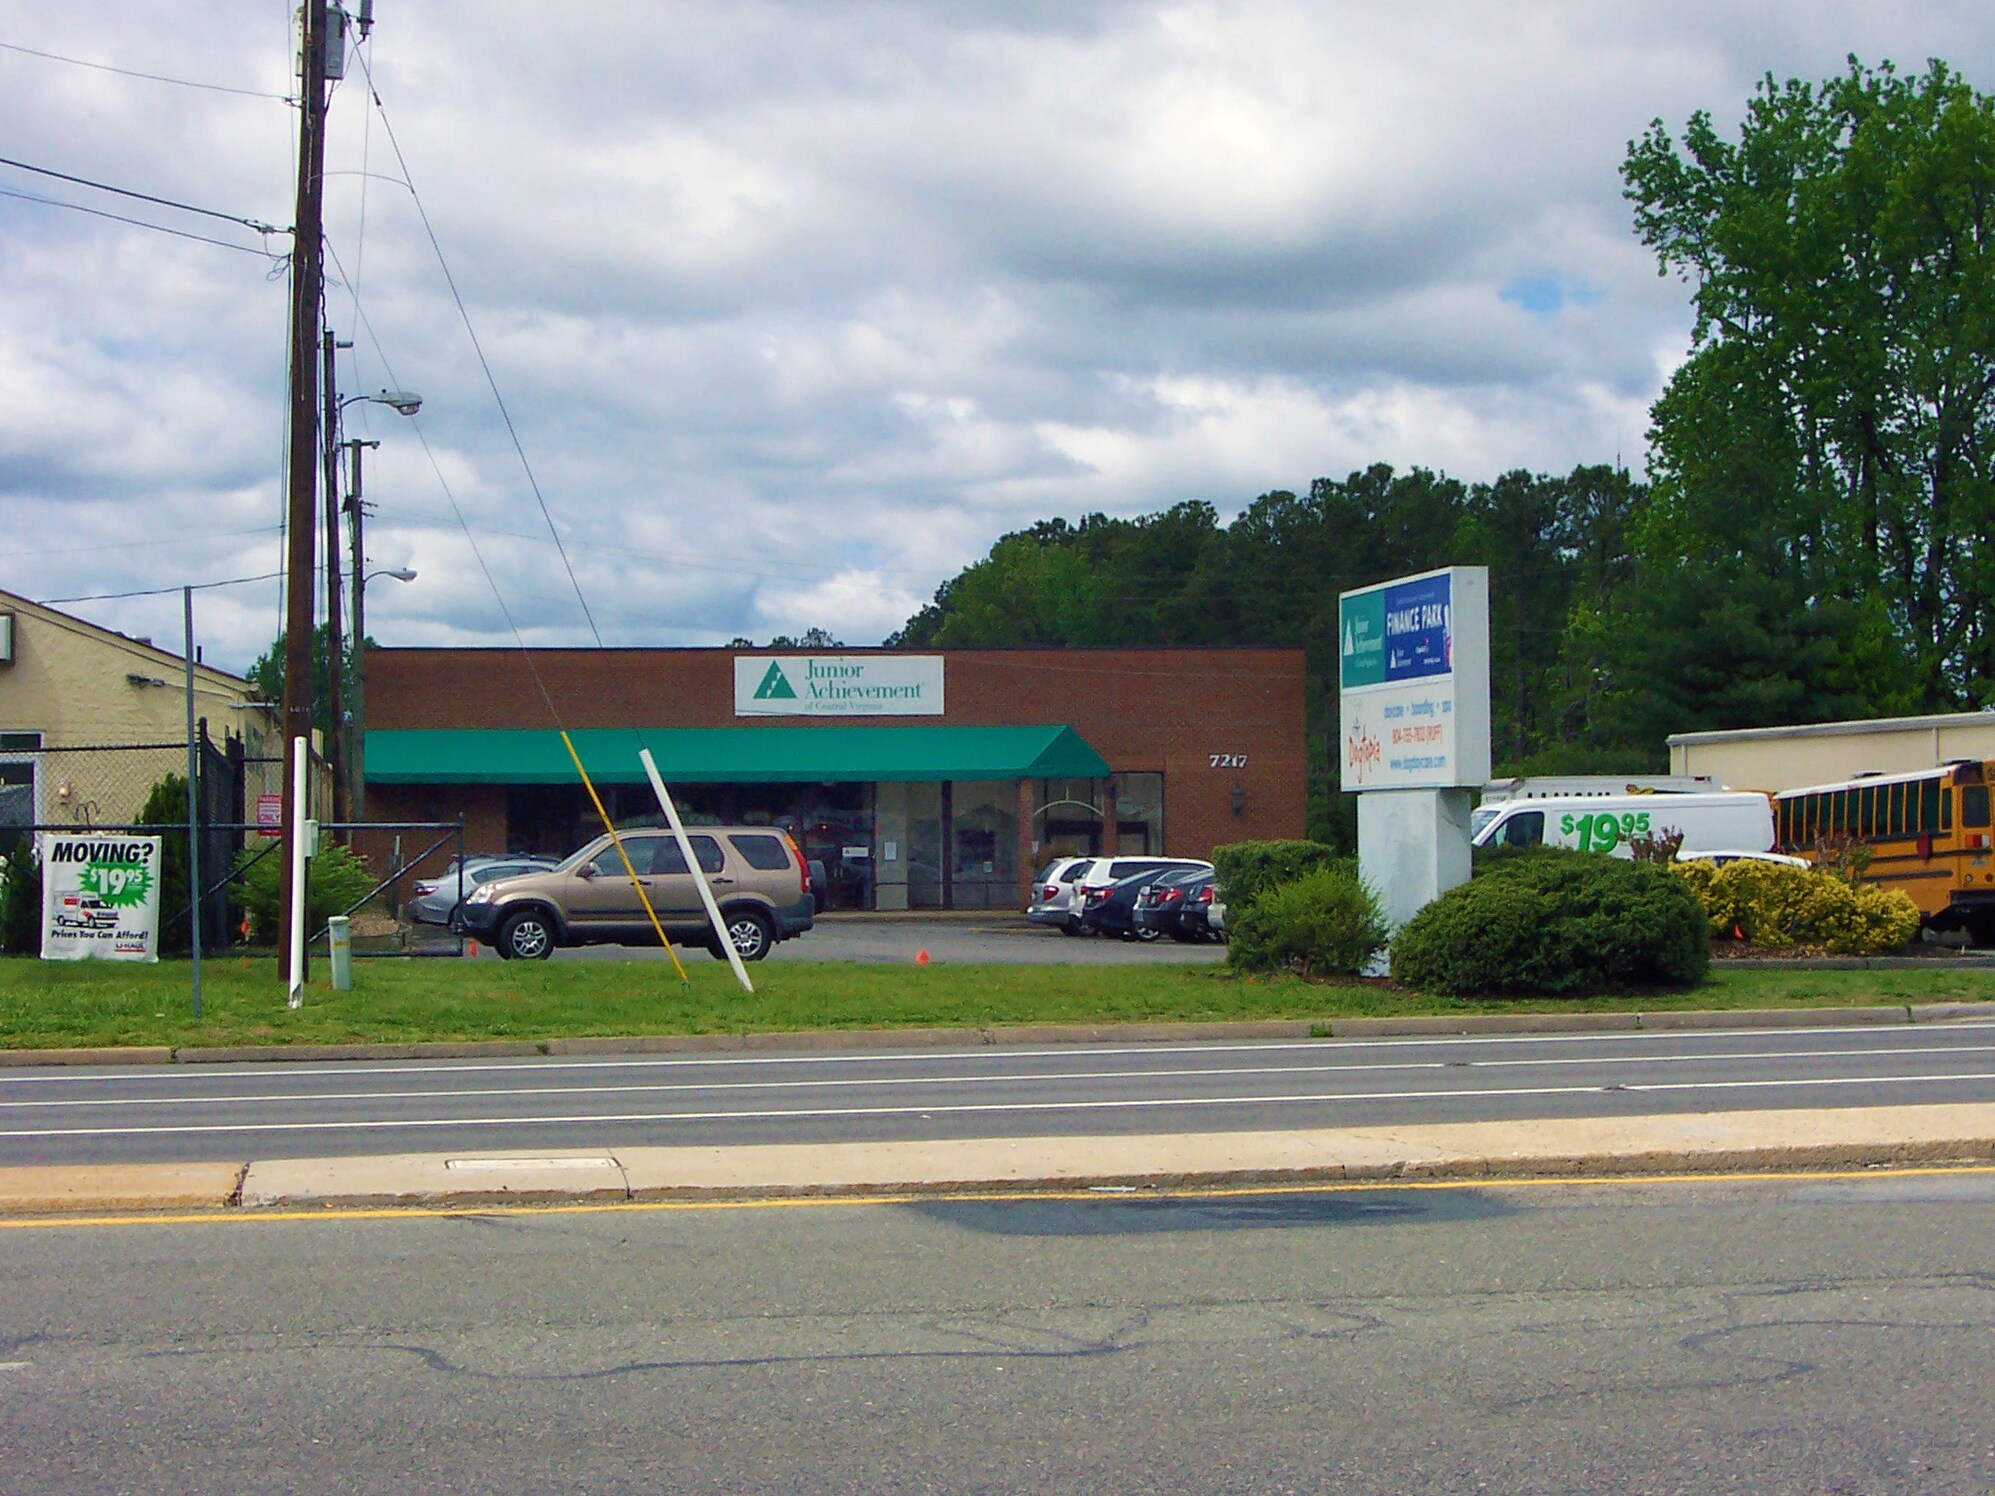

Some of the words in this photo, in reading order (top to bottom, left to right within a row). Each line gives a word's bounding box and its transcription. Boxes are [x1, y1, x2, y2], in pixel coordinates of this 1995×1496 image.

[1387, 607, 1420, 636] FINANCE
[1422, 604, 1443, 630] PARK
[805, 658, 864, 680] Junior
[806, 681, 922, 700] Achievement
[1209, 754, 1247, 767] 7217
[51, 842, 154, 864] MOVING?
[51, 929, 77, 939] Prices
[80, 930, 95, 939] You
[97, 931, 114, 939] Can
[116, 931, 149, 940] Afford!
